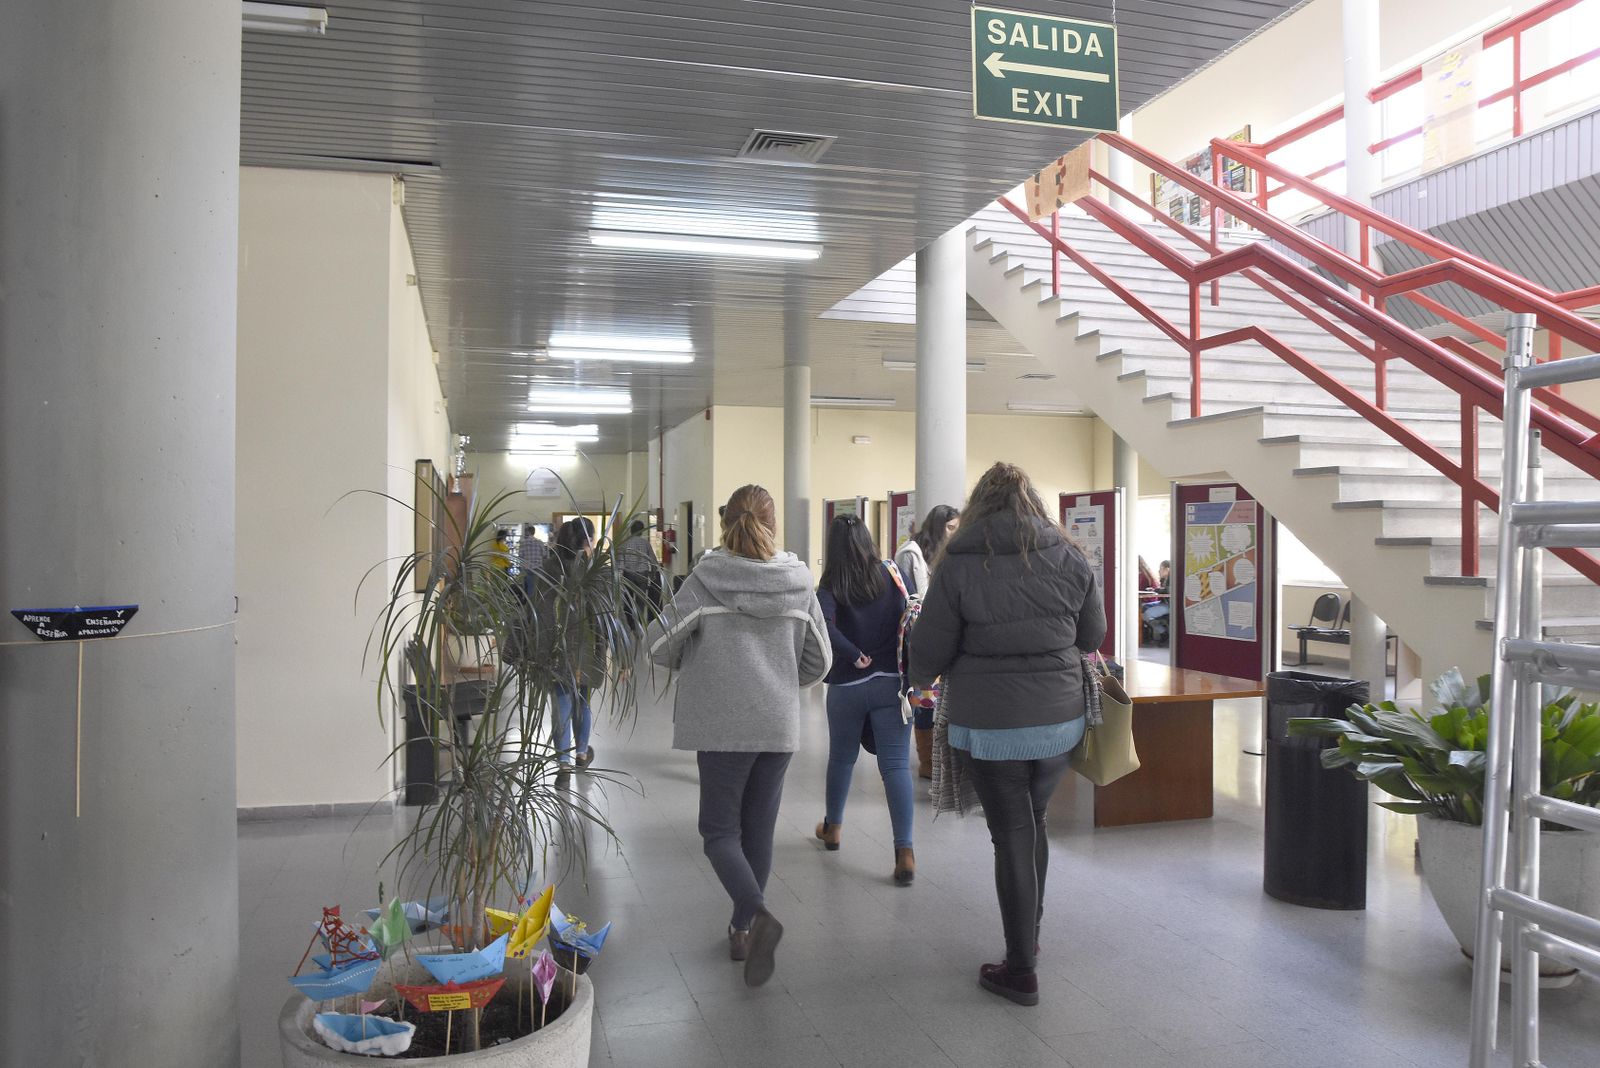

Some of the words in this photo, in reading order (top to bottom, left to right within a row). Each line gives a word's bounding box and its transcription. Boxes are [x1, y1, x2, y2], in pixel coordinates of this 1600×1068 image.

[987, 18, 1104, 58] SALIDA
[1011, 87, 1083, 119] EXIT
[23, 614, 51, 623] APRENDE
[85, 616, 126, 626] ENSEÑANDO
